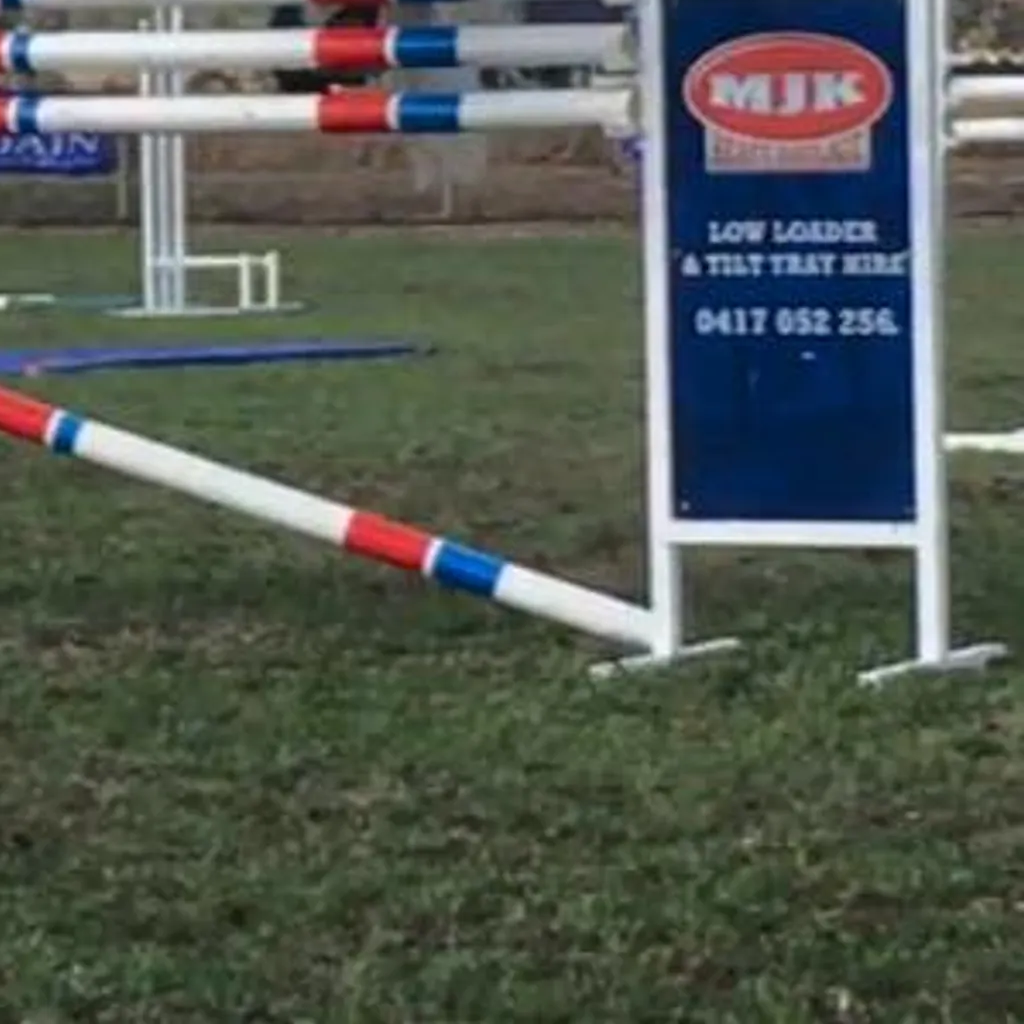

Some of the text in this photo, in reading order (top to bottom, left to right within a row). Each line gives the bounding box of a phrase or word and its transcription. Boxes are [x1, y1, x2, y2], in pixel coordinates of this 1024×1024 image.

[708, 72, 868, 115] MJK
[708, 221, 878, 243] LOW LOADER
[704, 253, 764, 277] TILT
[769, 253, 837, 276] TRAY
[694, 308, 769, 335] 0417
[776, 308, 831, 335] 052
